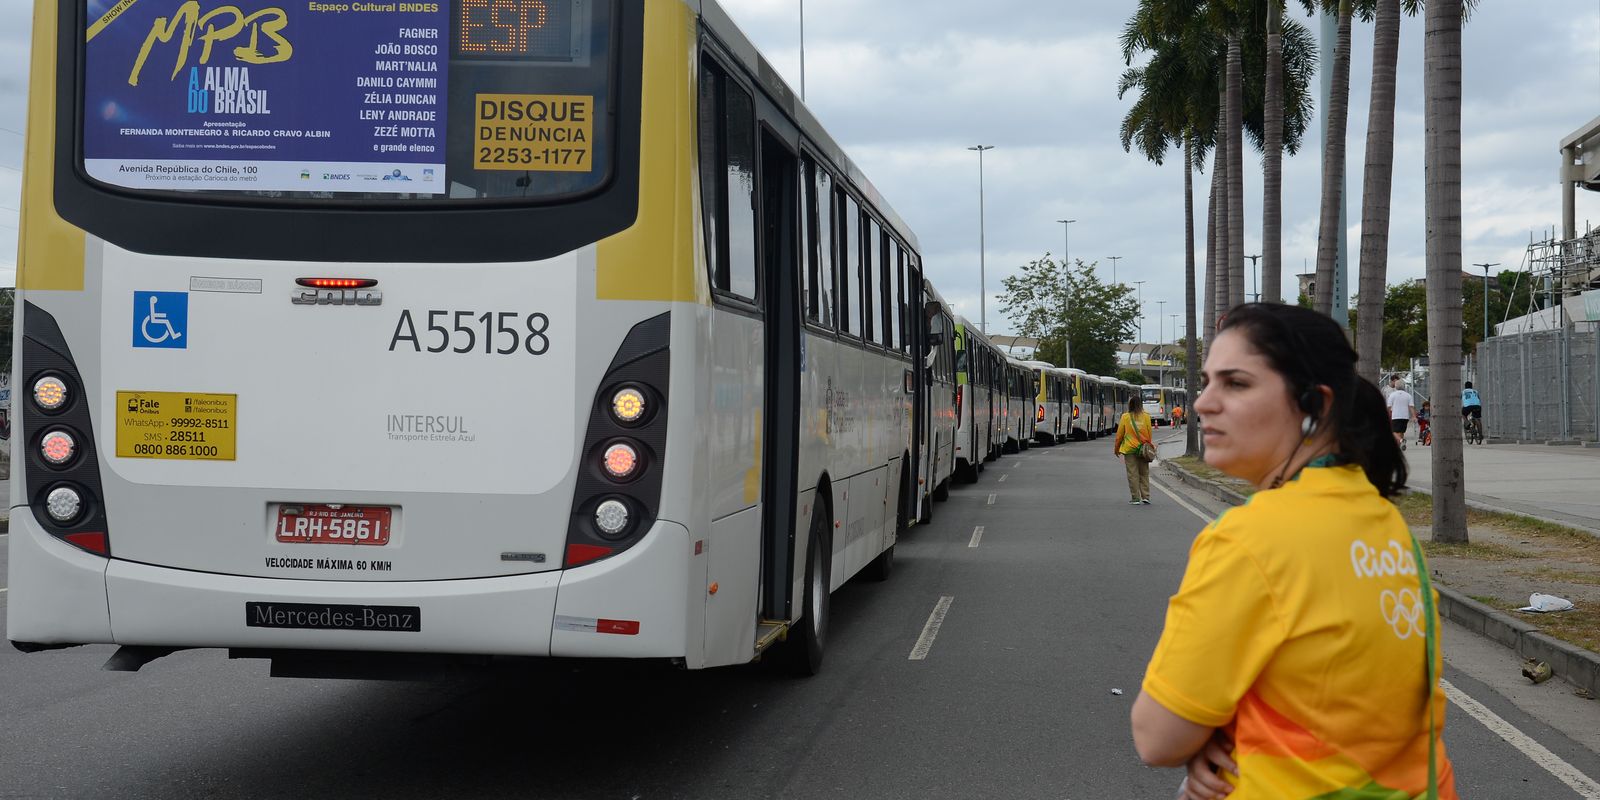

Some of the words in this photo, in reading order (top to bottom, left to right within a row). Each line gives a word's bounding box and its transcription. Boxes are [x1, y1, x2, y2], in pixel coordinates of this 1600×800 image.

[308, 2, 349, 13] Espaço
[351, 3, 396, 12] Cultural
[399, 3, 439, 12] BNDES
[102, 4, 123, 24] SHOW
[461, 0, 546, 52] ESP
[399, 28, 438, 39] FAGNER
[128, 0, 293, 86] MPB
[374, 42, 401, 55] JOÃO
[403, 44, 438, 55] BOSCO
[375, 60, 438, 72] MART'NALIA
[188, 67, 200, 91] A
[204, 67, 250, 91] ALMA
[356, 77, 394, 88] DANILO
[396, 77, 437, 88] CAYMMI
[187, 89, 208, 114] DO
[214, 89, 271, 114] BRASIL
[364, 91, 392, 104] ZÉLIA
[394, 94, 437, 105] DUNCAN
[359, 110, 386, 121] LENY
[387, 110, 436, 121] ANDRADE
[480, 101, 586, 122] DISQUE
[203, 120, 247, 129] Apresentação
[120, 128, 164, 137] FERNANDA
[165, 128, 222, 137] MONTENEGRO
[224, 129, 230, 137] &
[232, 129, 271, 138] RICARDO
[273, 130, 303, 138] CRAVO
[374, 126, 398, 138] ZEZÉ
[400, 127, 436, 138] MOTTA
[480, 123, 586, 143] DENÚNCIA
[380, 143, 407, 154] grande
[409, 143, 435, 153] elenco
[479, 147, 586, 165] 2253-1177
[119, 165, 154, 173] Avenida
[156, 165, 199, 175] República
[201, 165, 213, 174] do
[215, 165, 240, 175] Chile,
[242, 166, 258, 174] 100
[145, 174, 171, 182] Próximo
[178, 174, 203, 183] estação
[204, 174, 228, 182] Carioca
[230, 174, 238, 182] do
[239, 174, 258, 182] metrô
[330, 173, 351, 181] BNDES
[388, 308, 551, 356] A55158
[140, 399, 160, 408] Fale
[124, 419, 165, 428] WhatsApp
[171, 418, 229, 429] 99992-8511
[387, 414, 468, 434] INTERSUL
[144, 432, 162, 441] SMS
[170, 431, 206, 443] 28511
[388, 432, 428, 442] Transporte
[430, 433, 456, 442] Estrela
[457, 433, 475, 442] Azul
[134, 443, 163, 455] 0800
[165, 445, 187, 455] 886
[189, 445, 218, 457] 1000
[265, 557, 314, 569] VELOCIDADE
[316, 557, 354, 570] MÁXIMA
[356, 560, 367, 570] 60
[370, 560, 392, 571] KM/H
[1350, 539, 1418, 577] Rio20
[255, 605, 413, 629] Mercedes-Benz
